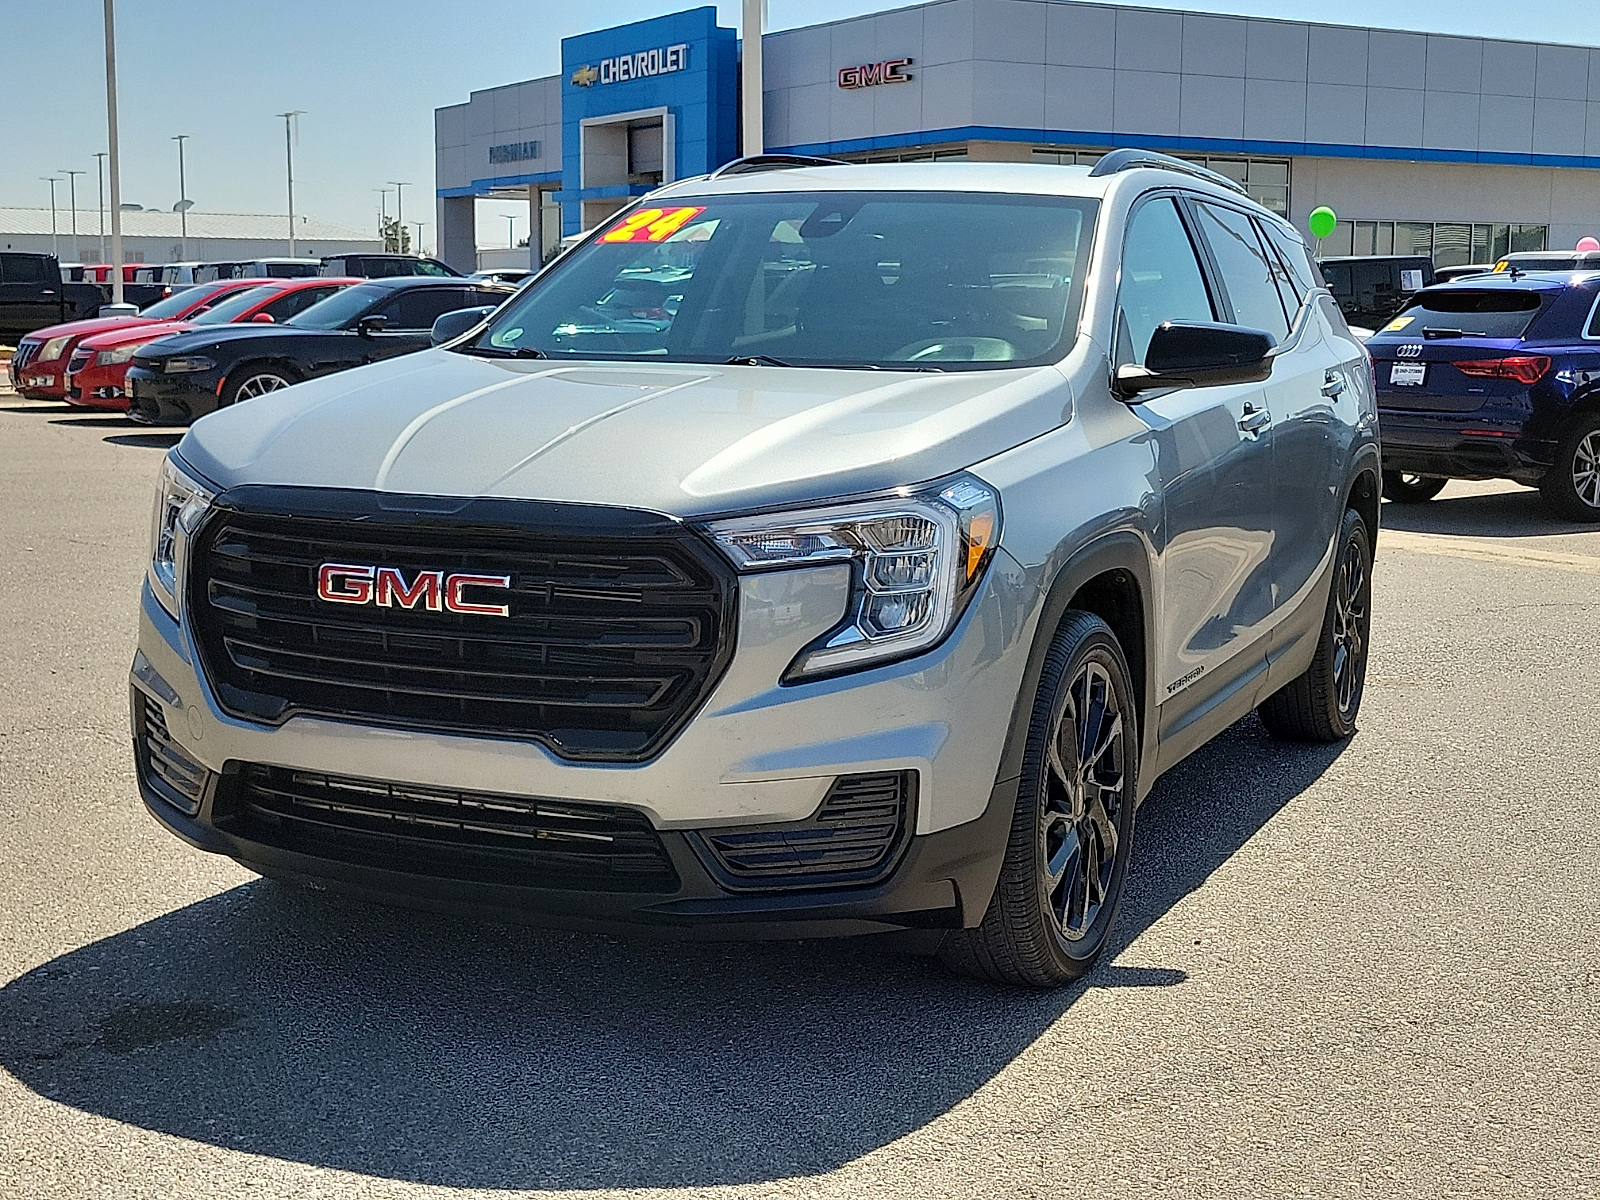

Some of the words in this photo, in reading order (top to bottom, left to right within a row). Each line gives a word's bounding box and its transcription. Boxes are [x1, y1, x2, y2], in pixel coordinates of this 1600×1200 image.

[600, 43, 687, 85] CHEVROLET
[837, 58, 911, 89] GMC
[604, 207, 698, 242] 24
[317, 562, 511, 617] GMC
